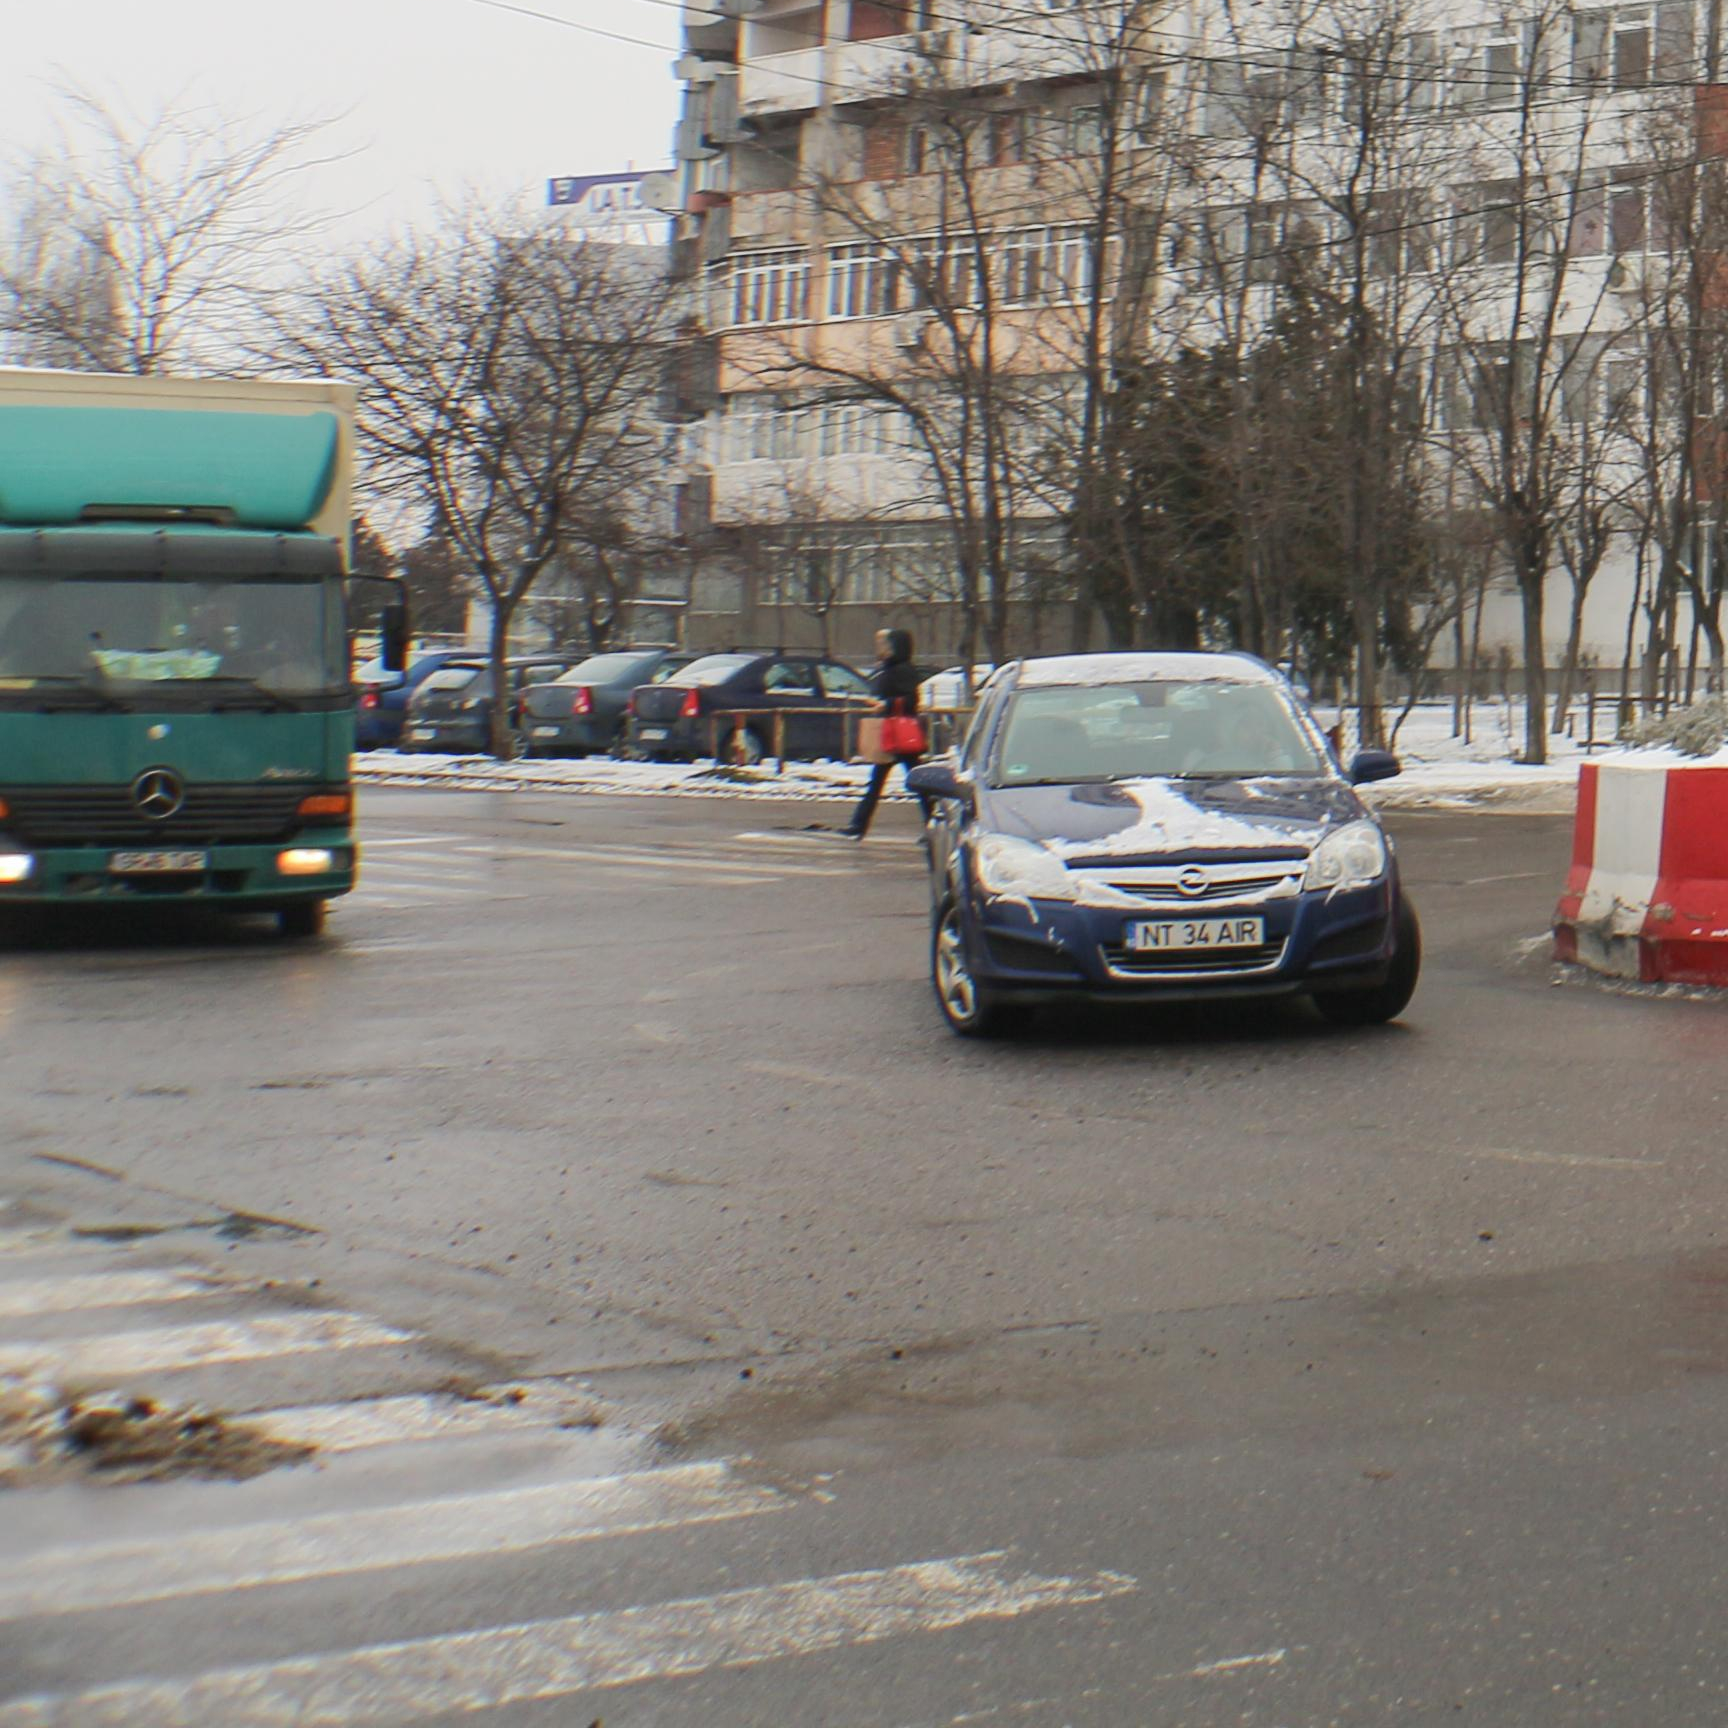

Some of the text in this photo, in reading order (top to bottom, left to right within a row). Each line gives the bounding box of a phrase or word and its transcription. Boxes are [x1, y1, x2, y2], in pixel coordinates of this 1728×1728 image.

[1143, 920, 1258, 947] NT 34 AIR
